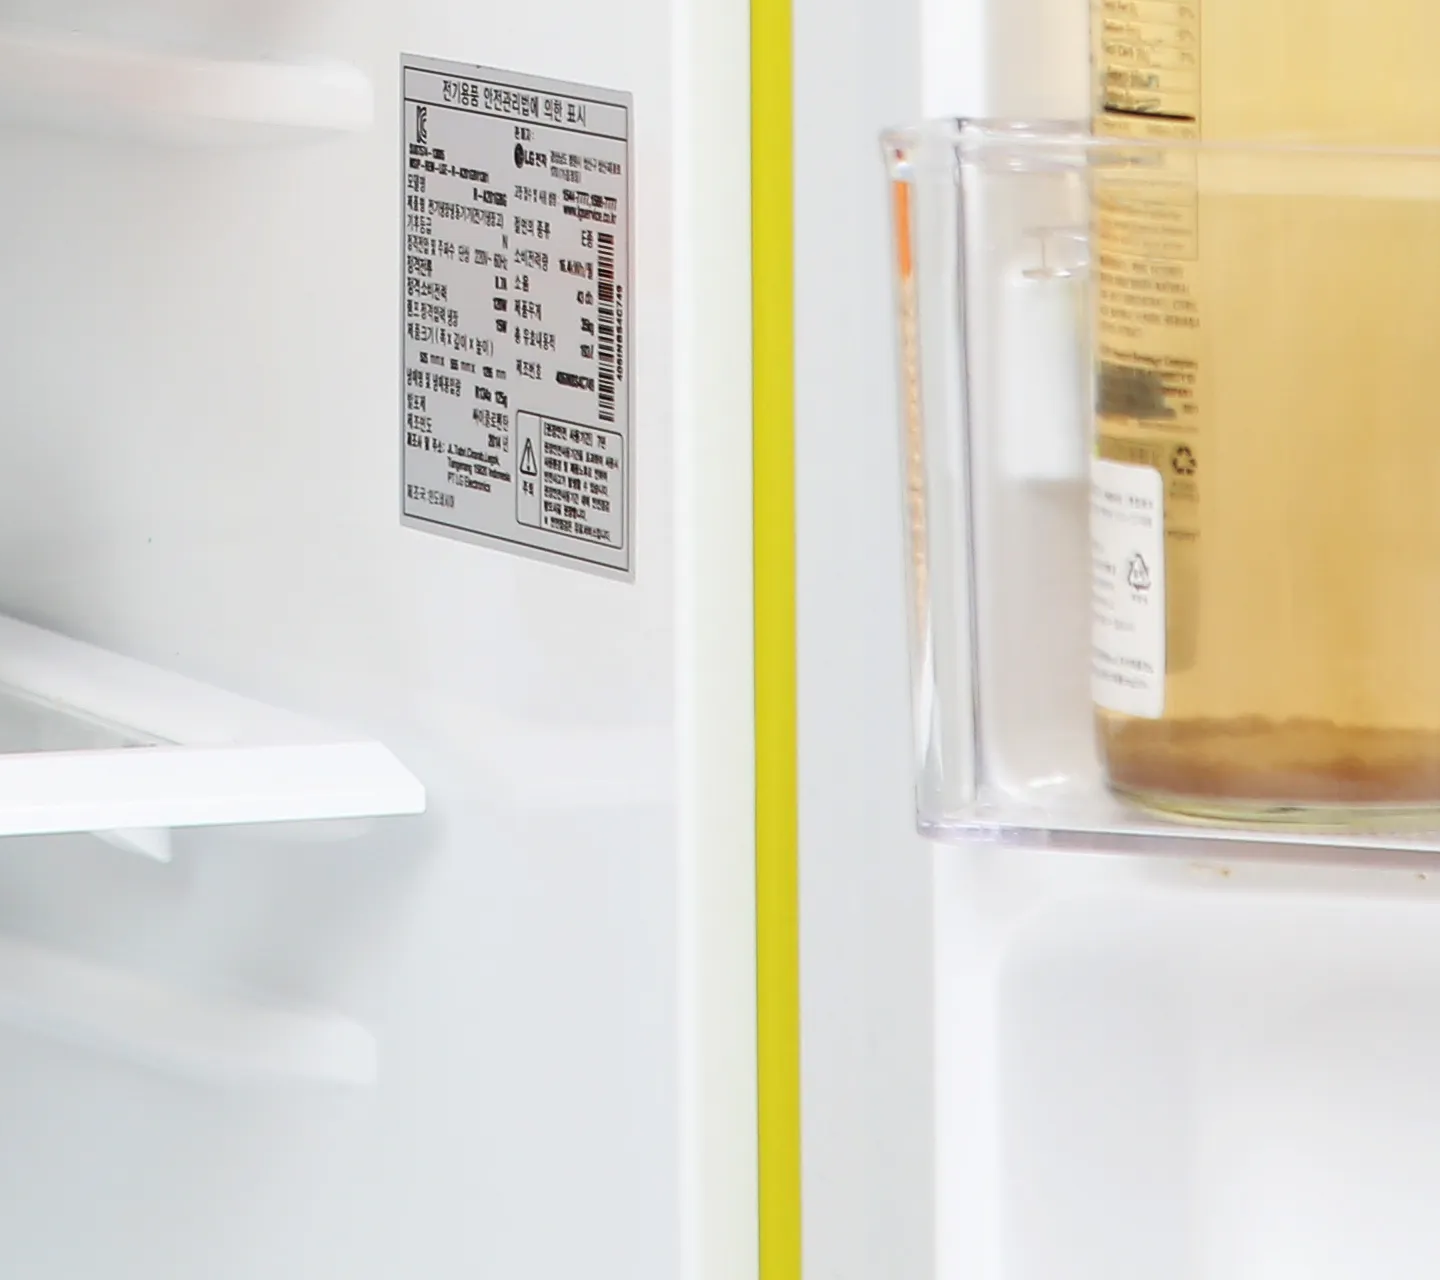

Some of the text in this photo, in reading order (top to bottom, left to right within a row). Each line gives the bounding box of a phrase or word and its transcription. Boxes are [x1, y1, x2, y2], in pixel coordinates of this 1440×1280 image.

[442, 78, 586, 127] 전기용품 안전관리법에 의한 표시
